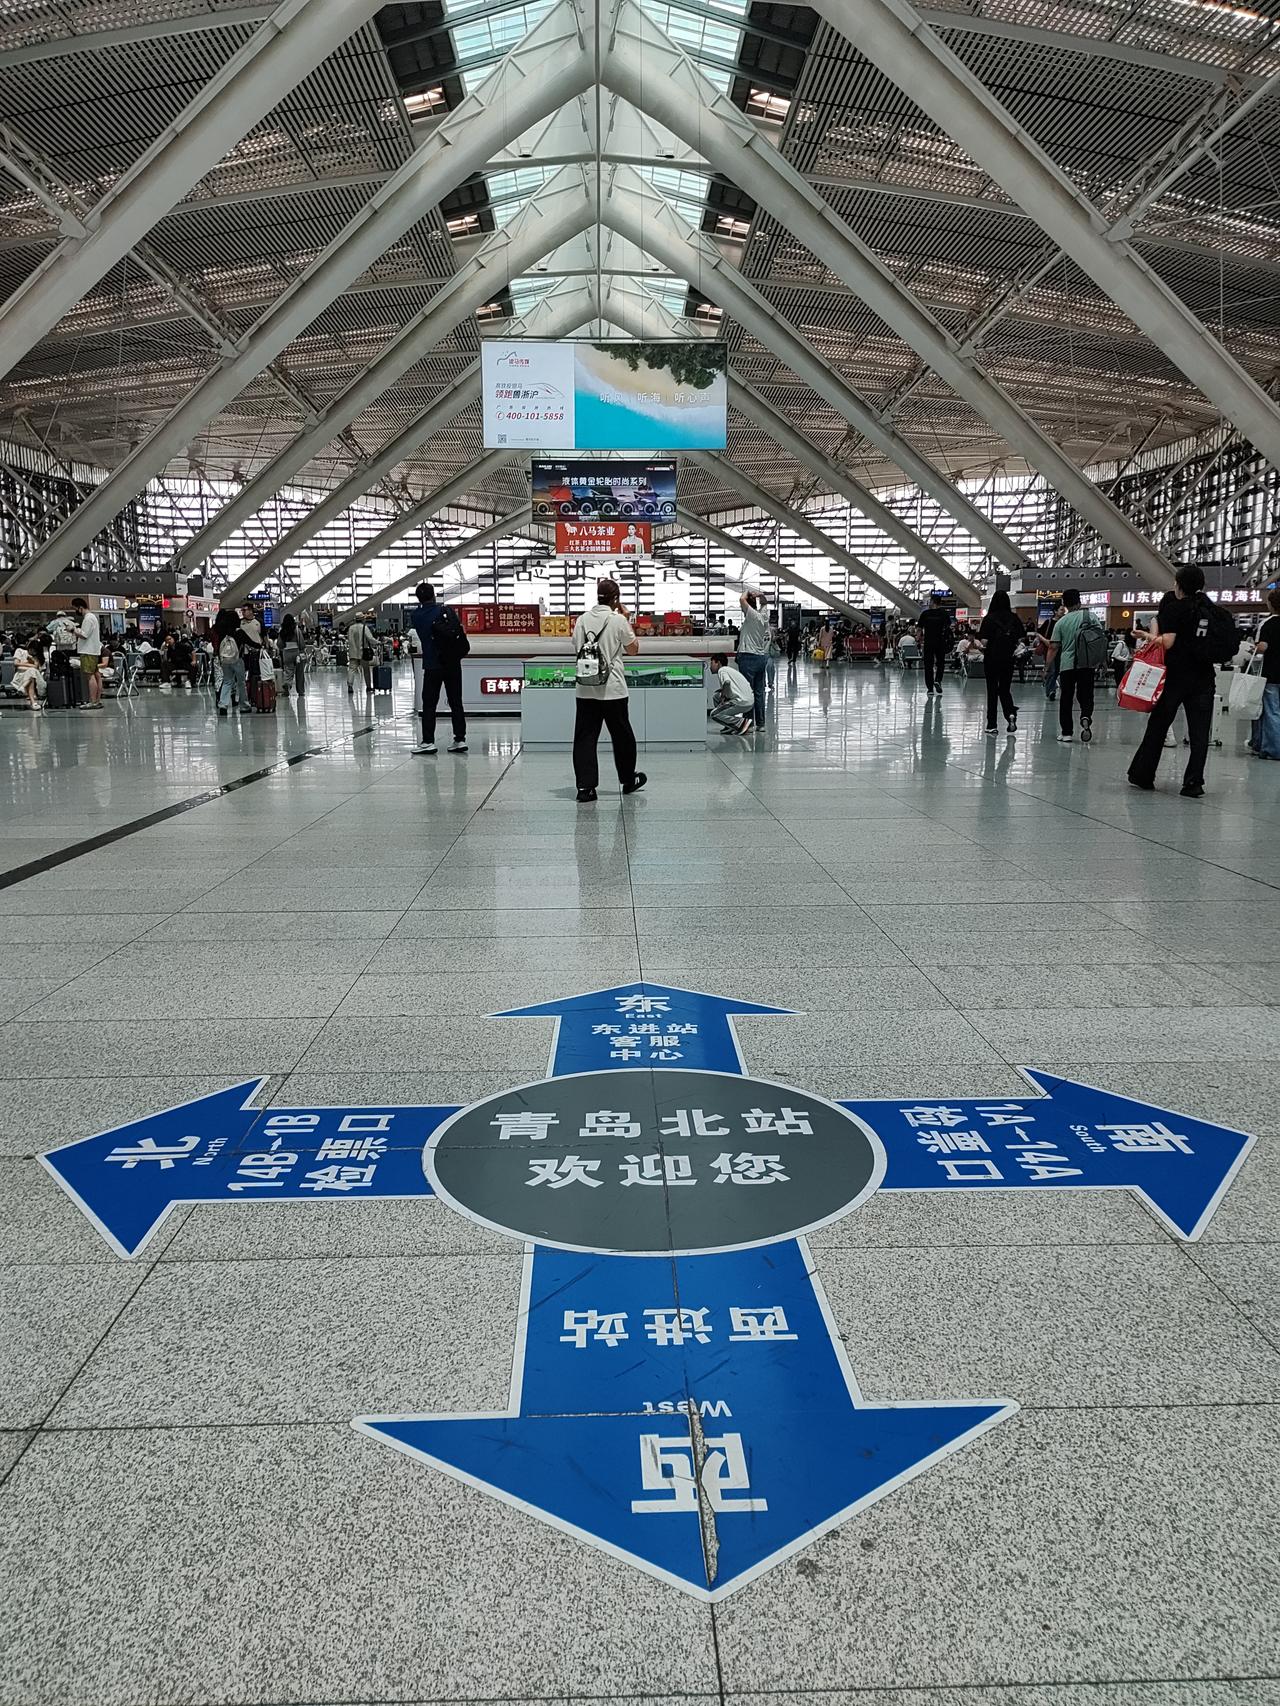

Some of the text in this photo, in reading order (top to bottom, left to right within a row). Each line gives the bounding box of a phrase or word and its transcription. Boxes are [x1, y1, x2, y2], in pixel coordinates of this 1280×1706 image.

[506, 411, 564, 421] 400-101-5858
[561, 476, 647, 487] 液体黄金轮胎时尚系列
[579, 525, 616, 536] 八马茶业
[615, 994, 672, 1012] 东
[591, 1023, 698, 1035] 东进站
[609, 1035, 682, 1047] 客服
[610, 1048, 685, 1061] 中心
[489, 1107, 815, 1140] 青岛北站
[1095, 1121, 1195, 1154] 南
[104, 1135, 201, 1169] 北
[192, 1137, 228, 1166] North
[299, 1114, 396, 1191] 检票口
[899, 1105, 1005, 1180] 检票口
[1069, 1124, 1106, 1153] South
[524, 1152, 792, 1189] 欢迎您
[559, 1305, 799, 1348] 西进站
[642, 1400, 733, 1417] West
[631, 1432, 769, 1514] 西
